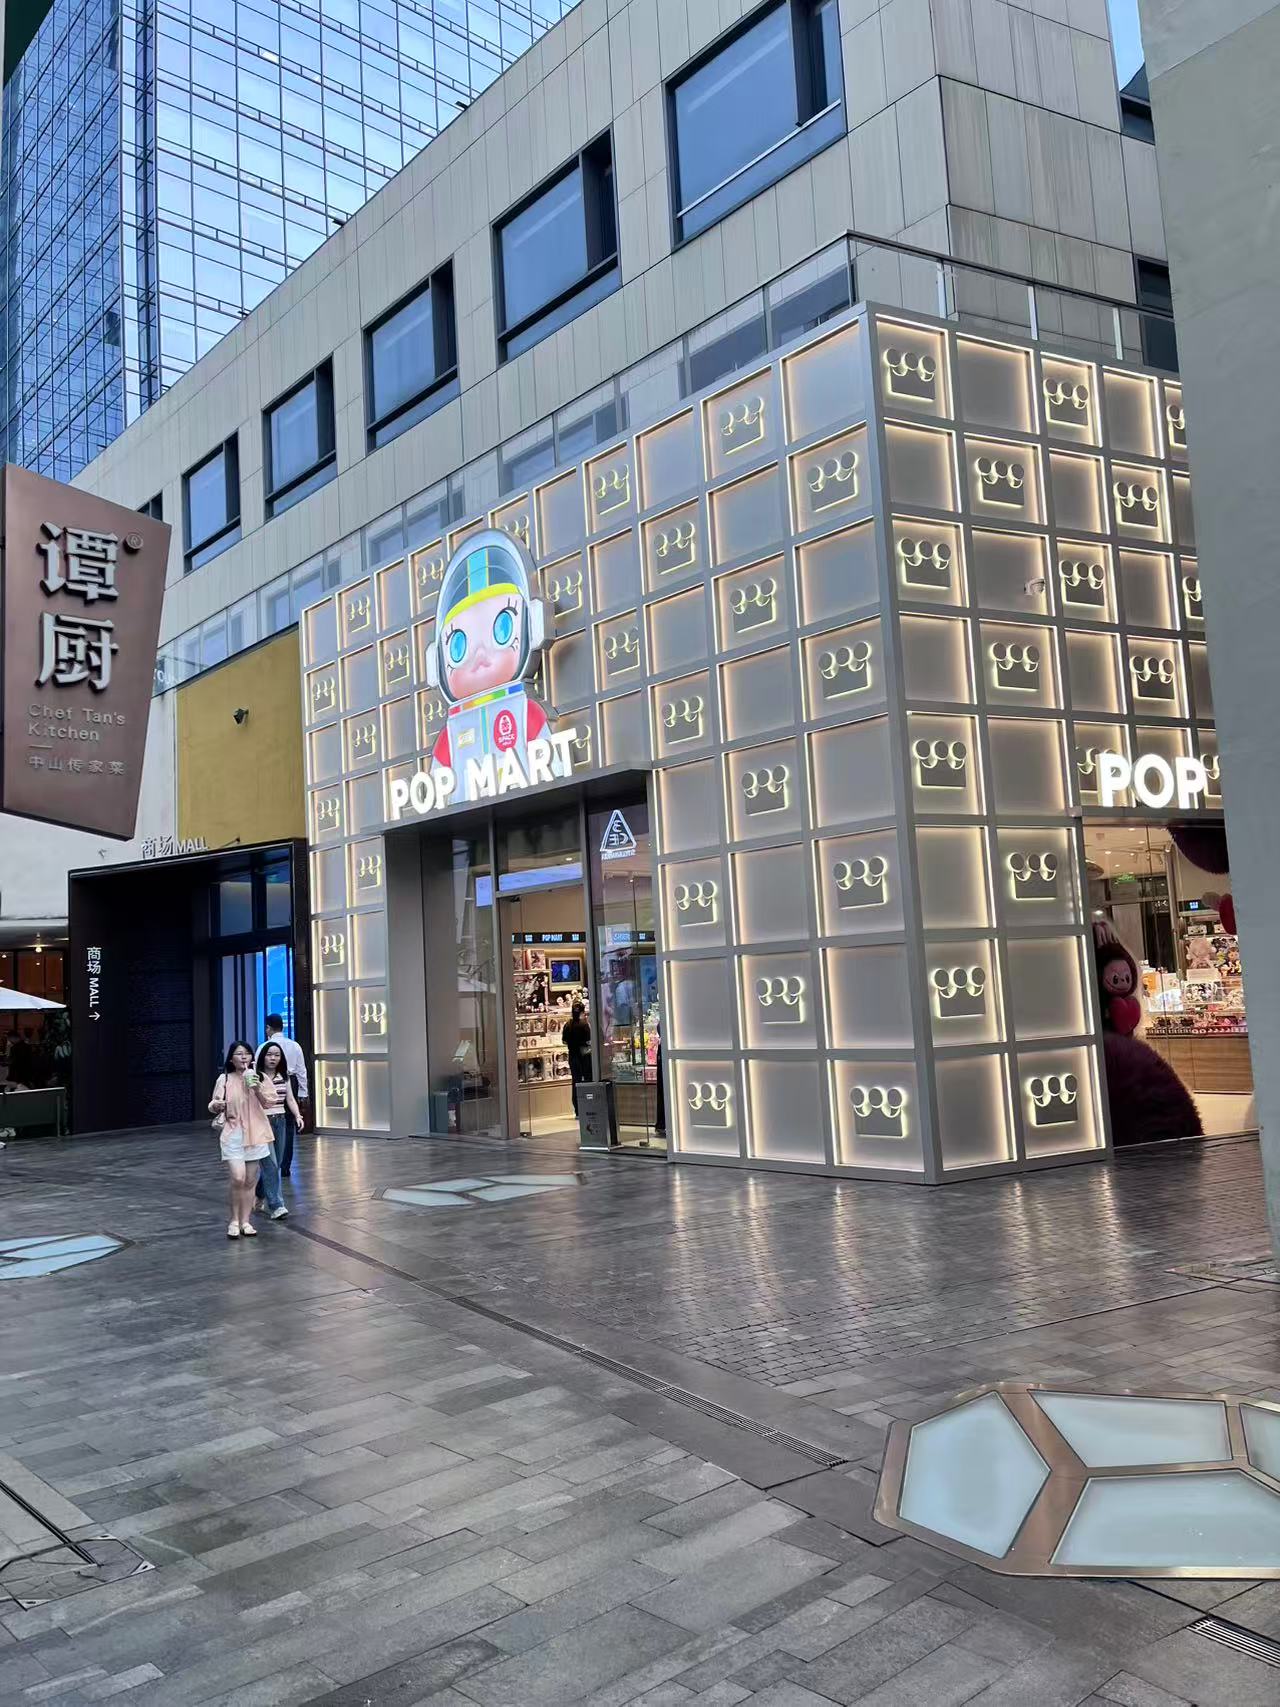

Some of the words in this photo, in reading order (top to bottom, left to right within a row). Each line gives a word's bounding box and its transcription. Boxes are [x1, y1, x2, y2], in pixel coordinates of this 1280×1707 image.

[35, 522, 119, 693] 谭厨
[28, 703, 73, 720] Chef
[82, 707, 126, 725] Tan's
[28, 722, 99, 740] Kitchen
[29, 756, 125, 775] 中山传家菜
[390, 768, 456, 821] POP
[466, 728, 577, 801] MART
[1095, 753, 1208, 809] POP
[141, 835, 174, 859] 商场
[175, 836, 208, 854] MALL
[86, 946, 102, 975] 商场
[89, 977, 100, 1008] MALL
